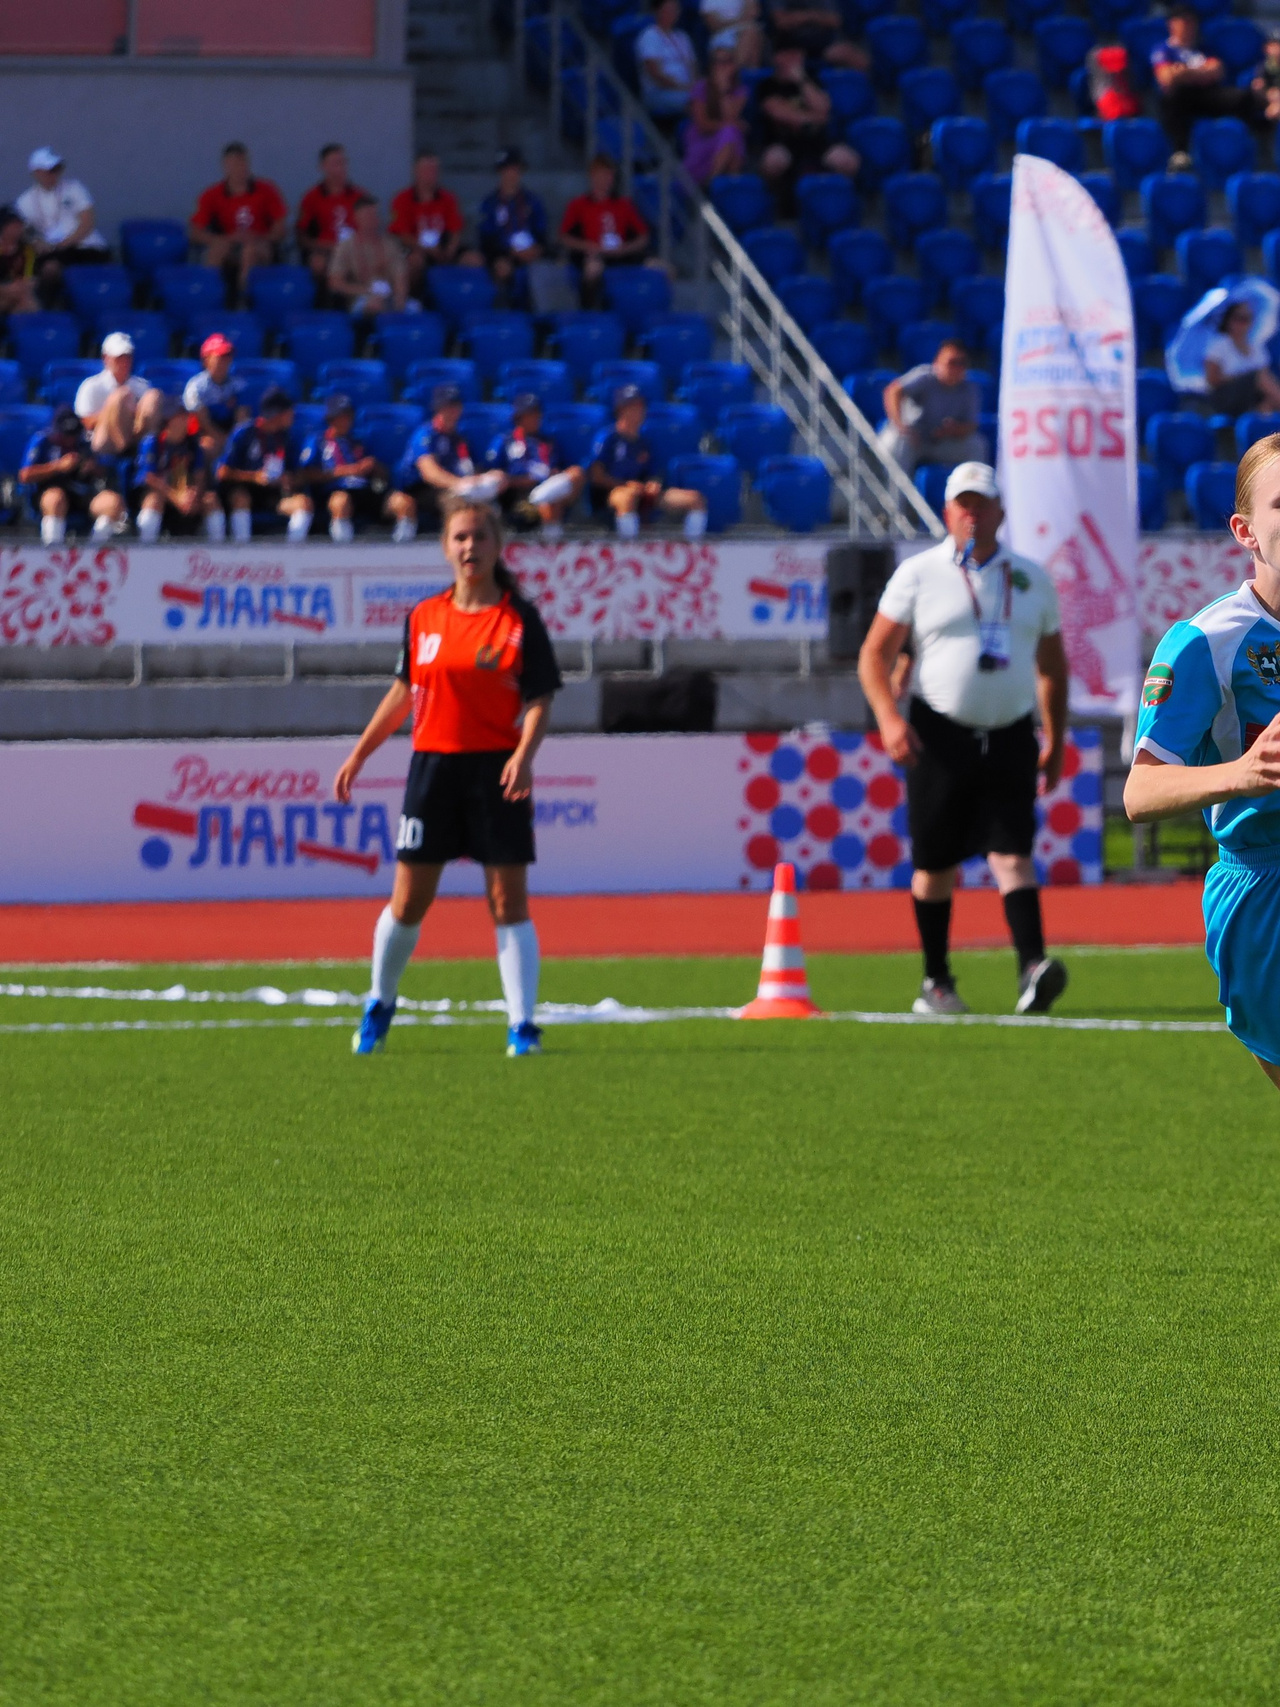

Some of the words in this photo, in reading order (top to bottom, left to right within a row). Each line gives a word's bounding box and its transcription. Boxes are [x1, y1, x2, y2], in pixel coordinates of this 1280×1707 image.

[197, 583, 336, 629] ЛАПТА
[416, 632, 442, 666] 10
[188, 803, 395, 868] ЛАПТА
[396, 814, 424, 850] 10
